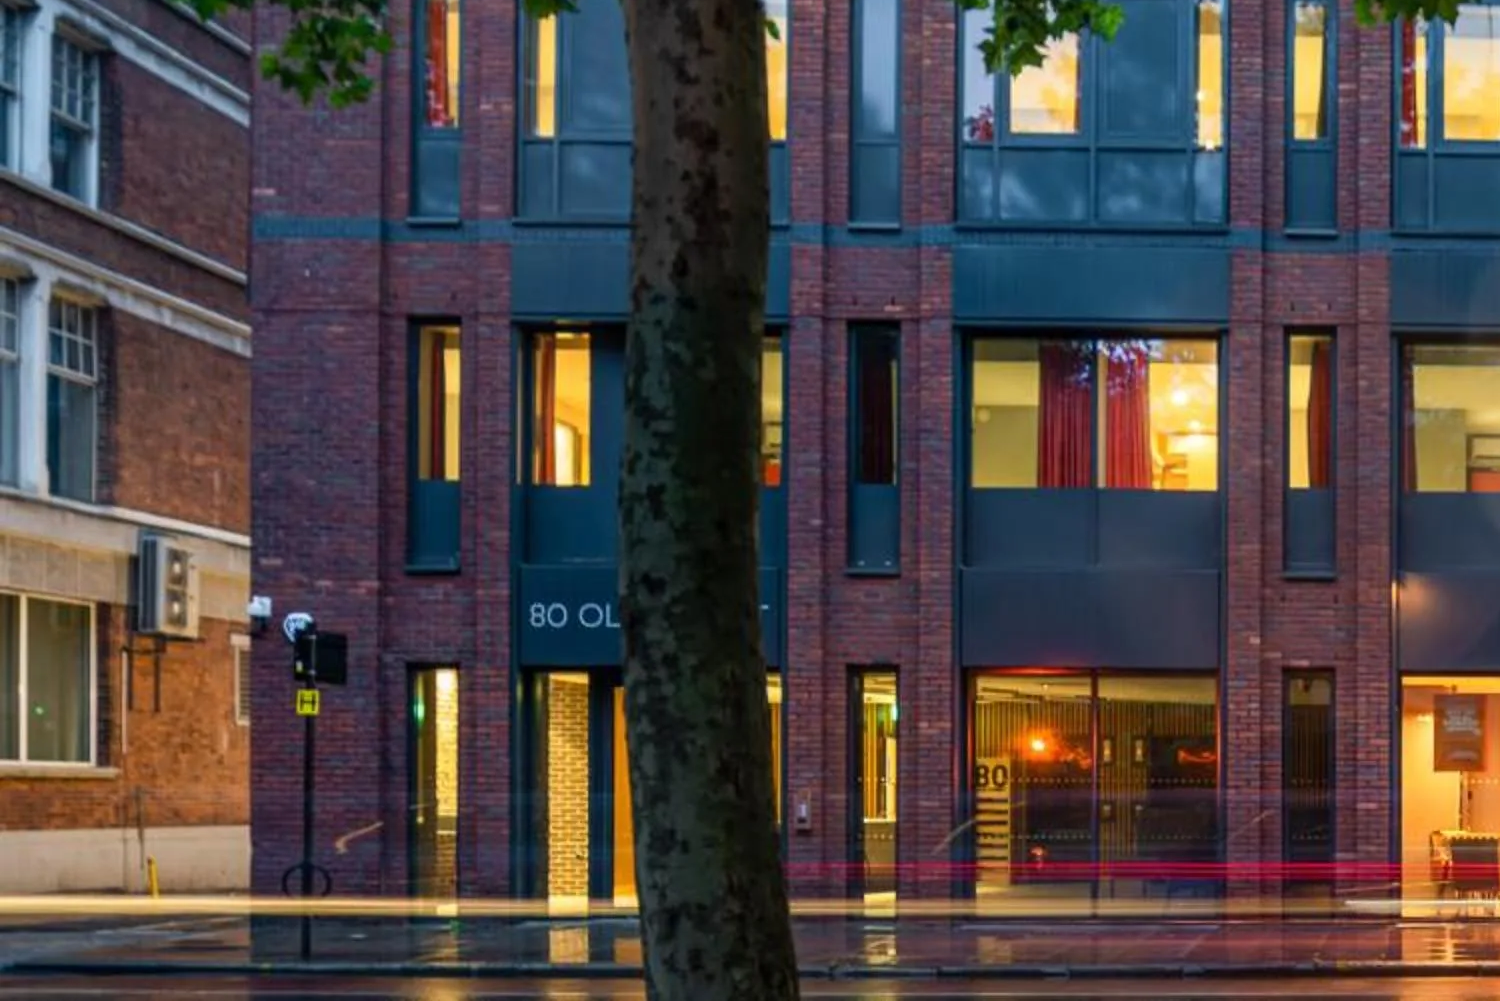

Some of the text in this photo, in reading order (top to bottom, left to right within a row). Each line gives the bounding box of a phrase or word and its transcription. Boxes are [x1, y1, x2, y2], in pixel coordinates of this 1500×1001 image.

[530, 603, 621, 628] 80 OL
[299, 692, 317, 712] H
[976, 764, 1009, 789] 80
